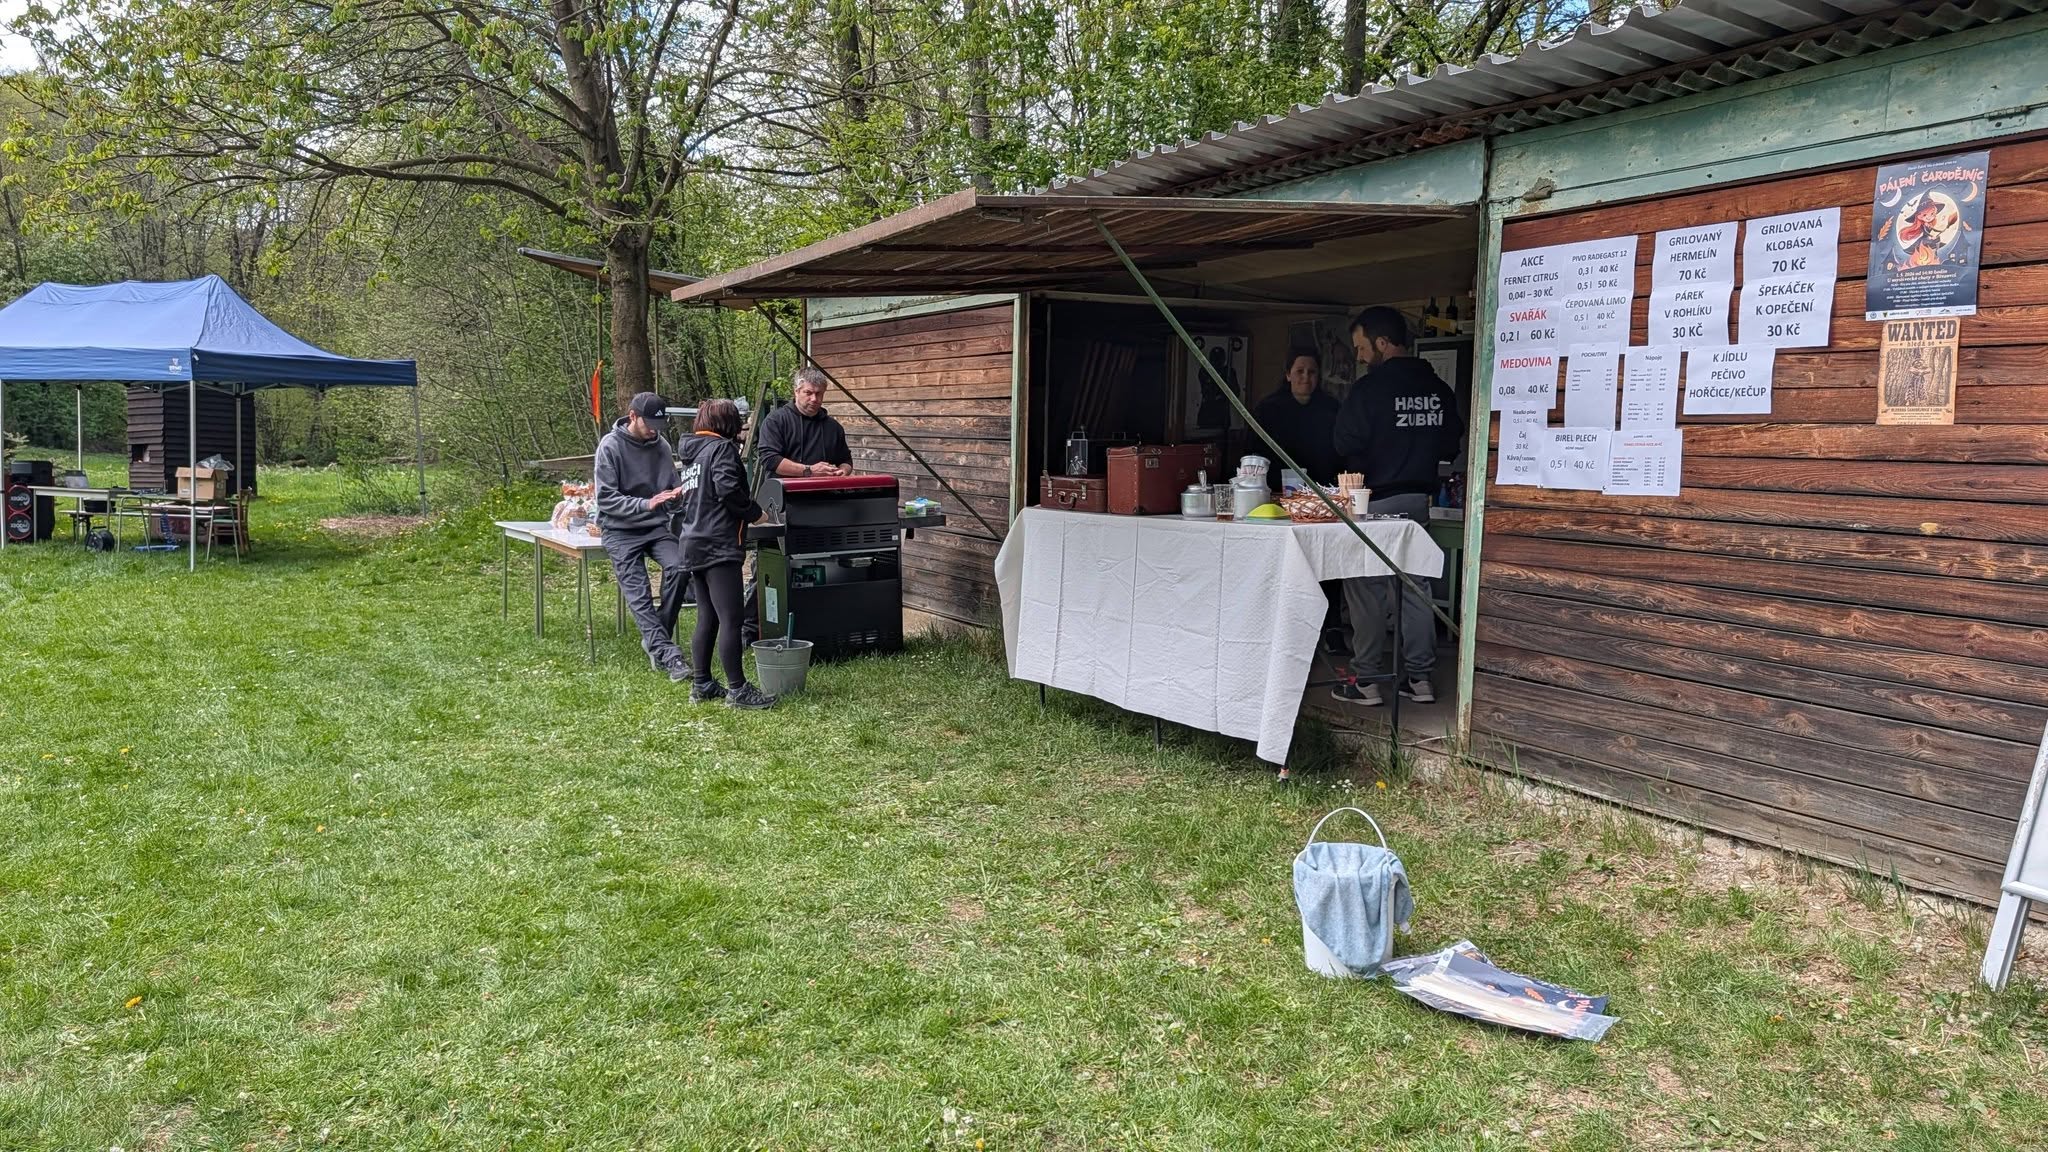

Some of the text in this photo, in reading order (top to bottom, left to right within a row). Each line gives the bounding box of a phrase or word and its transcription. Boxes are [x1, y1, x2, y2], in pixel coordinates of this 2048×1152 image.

[1880, 167, 1984, 194] PÁLENÍ ČARODĚJNIC
[1761, 216, 1822, 236] GRILOVANÁ
[1669, 231, 1722, 247] GRILOVANÝ
[1766, 237, 1814, 252] KLOBÁSA
[1520, 255, 1544, 268] AKCE
[1588, 251, 1618, 260] RADEGAST
[1670, 248, 1717, 262] HERMELÍN
[1578, 267, 1589, 276] 0,3
[1610, 264, 1618, 272] Kč
[1772, 257, 1806, 272] 70 Kč
[1504, 272, 1558, 286] FERNET CITRUS
[1679, 268, 1706, 280] 70 Kč
[1578, 282, 1588, 291] 0,5
[1598, 280, 1607, 288] 50
[1609, 279, 1618, 287] Kč
[1758, 282, 1814, 297] ŠPEKÁČEK
[1508, 291, 1526, 300] 0,04l
[1533, 289, 1542, 298] 30
[1544, 287, 1554, 297] KČ
[1675, 290, 1704, 302] PÁREK
[1566, 296, 1626, 309] ČEPOVANÁ LIMO
[1756, 299, 1814, 316] K OPEČENÍ
[1509, 308, 1547, 322] SVAŘÁK
[1574, 314, 1584, 322] 0,5
[1607, 310, 1615, 319] KČ
[1664, 306, 1712, 318] V ROHLÍKU
[1500, 332, 1514, 342] 0,2
[1530, 330, 1542, 340] 60
[1544, 328, 1555, 339] Kč
[1672, 323, 1703, 338] 30 KČ
[1767, 324, 1800, 336] 30 Kč
[1888, 320, 1957, 342] WANTED
[1500, 356, 1552, 369] MEDOVINA
[1713, 352, 1747, 362] K JÍDLU
[1711, 368, 1746, 380] PEČIVO
[1499, 384, 1549, 395] 0,08 40 Kč
[1689, 386, 1766, 398] HOŘČICE/KEČUP
[1394, 394, 1441, 411] HASIČ
[1396, 410, 1444, 427] ZUBŘÍ
[1555, 434, 1597, 442] BIREL PLECH
[1550, 460, 1562, 470] 0,5
[1574, 460, 1584, 469] 40
[1586, 460, 1594, 469] Kč
